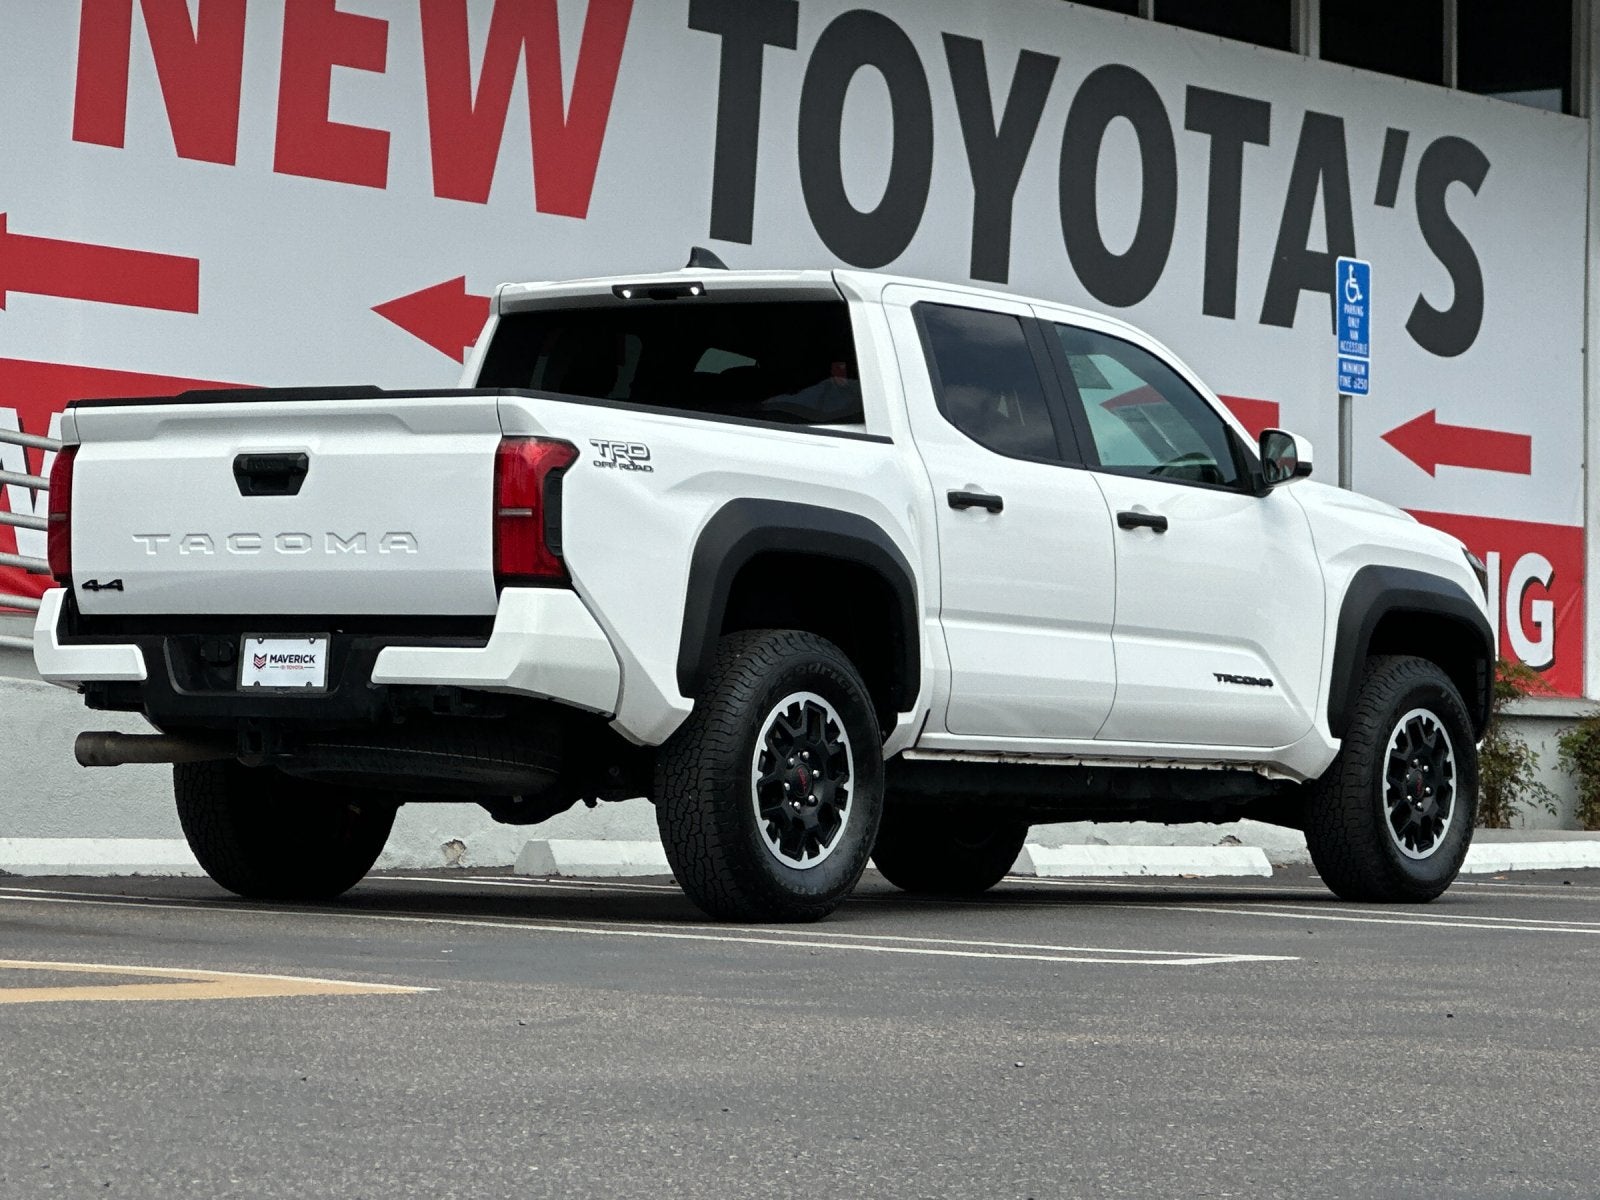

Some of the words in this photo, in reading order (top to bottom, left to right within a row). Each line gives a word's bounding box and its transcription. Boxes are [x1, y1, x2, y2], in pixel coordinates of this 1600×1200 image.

[72, 0, 634, 219] NEW
[688, 0, 1491, 358] TOYOTA'S
[1344, 304, 1364, 317] PARKING
[1348, 317, 1360, 328] ONLY
[1349, 330, 1359, 341] VAN
[1340, 340, 1368, 355] ACCESSIBLE
[1342, 362, 1365, 375] MINIMUM
[1340, 376, 1352, 387] FINE
[1353, 378, 1368, 390] $250
[589, 439, 651, 464] TRD
[592, 460, 617, 469] OFF
[619, 463, 653, 473] ROAD
[132, 531, 419, 555] TACOMA
[269, 654, 316, 664] MAVERICK
[1213, 672, 1274, 687] TACOMA
